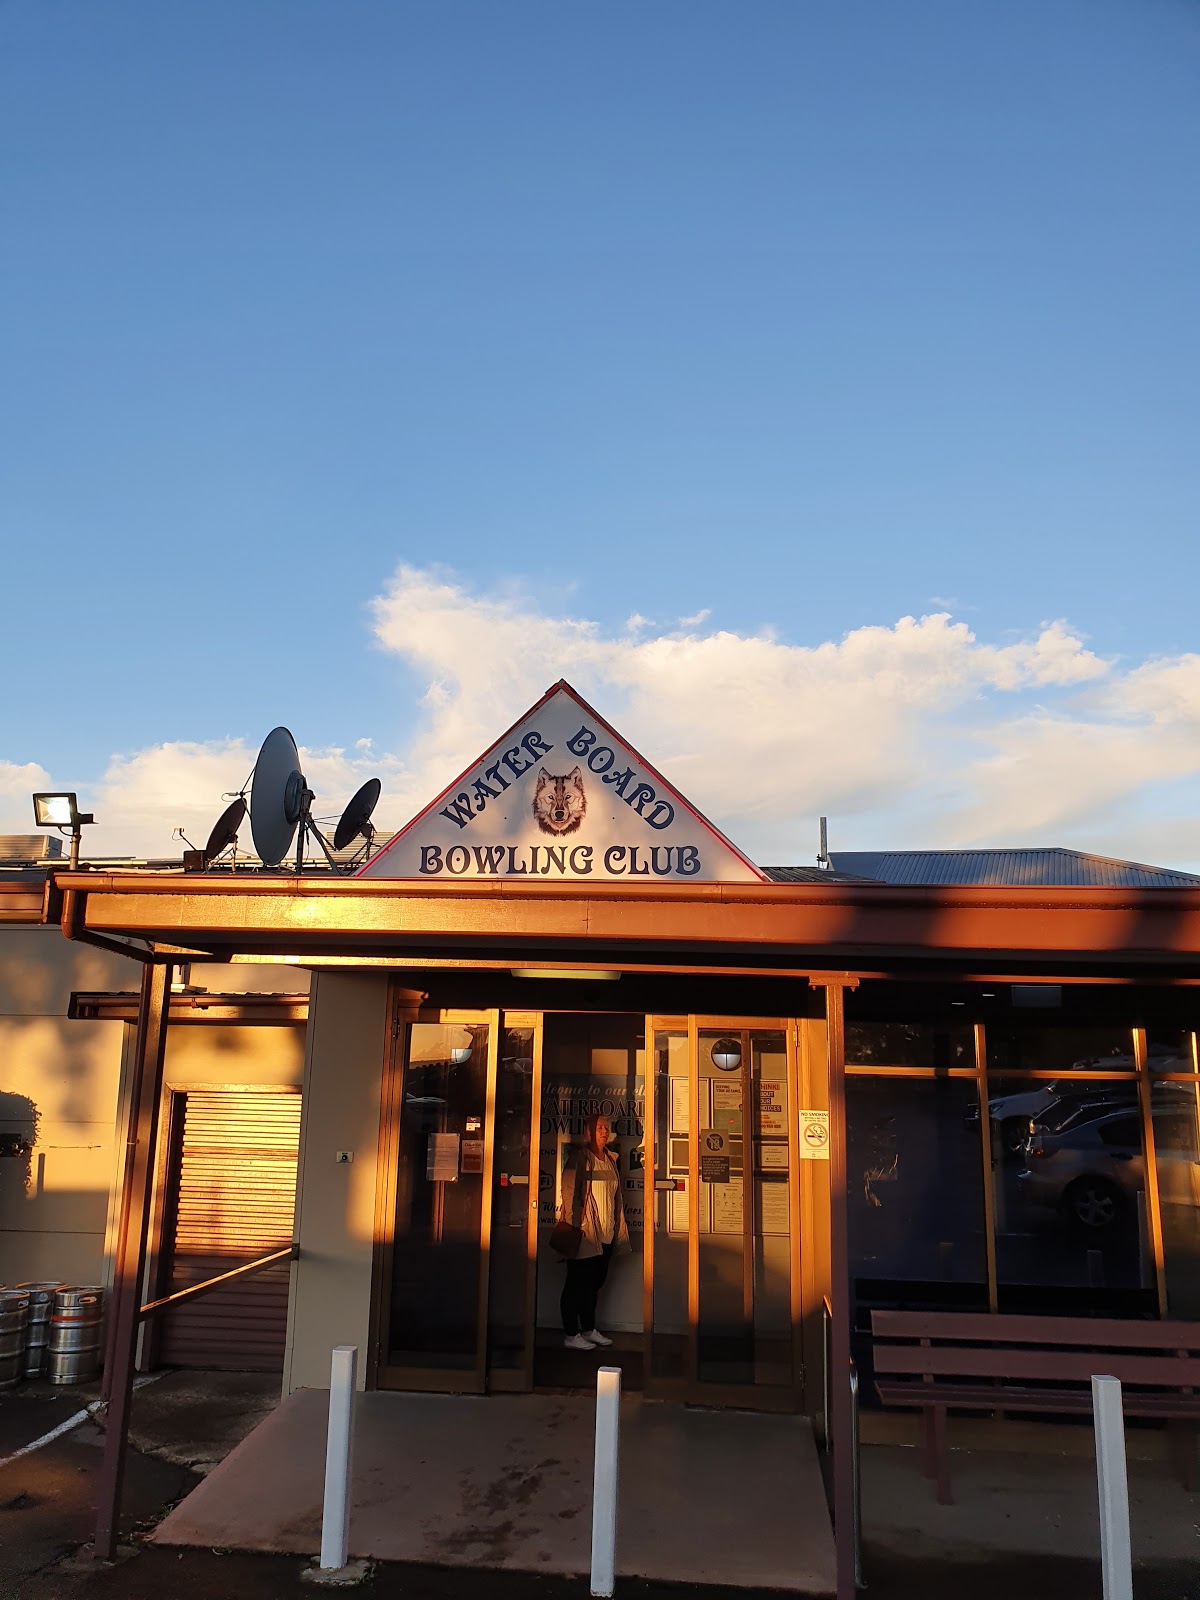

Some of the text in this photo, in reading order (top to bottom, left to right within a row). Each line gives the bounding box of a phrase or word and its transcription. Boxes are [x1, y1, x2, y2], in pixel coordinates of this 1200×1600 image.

[439, 725, 675, 830] WATER BOARD
[419, 845, 702, 876] BOWLING CLUB
[543, 1083, 584, 1094] lcome
[587, 1084, 600, 1095] to
[614, 1119, 646, 1137] CLU
